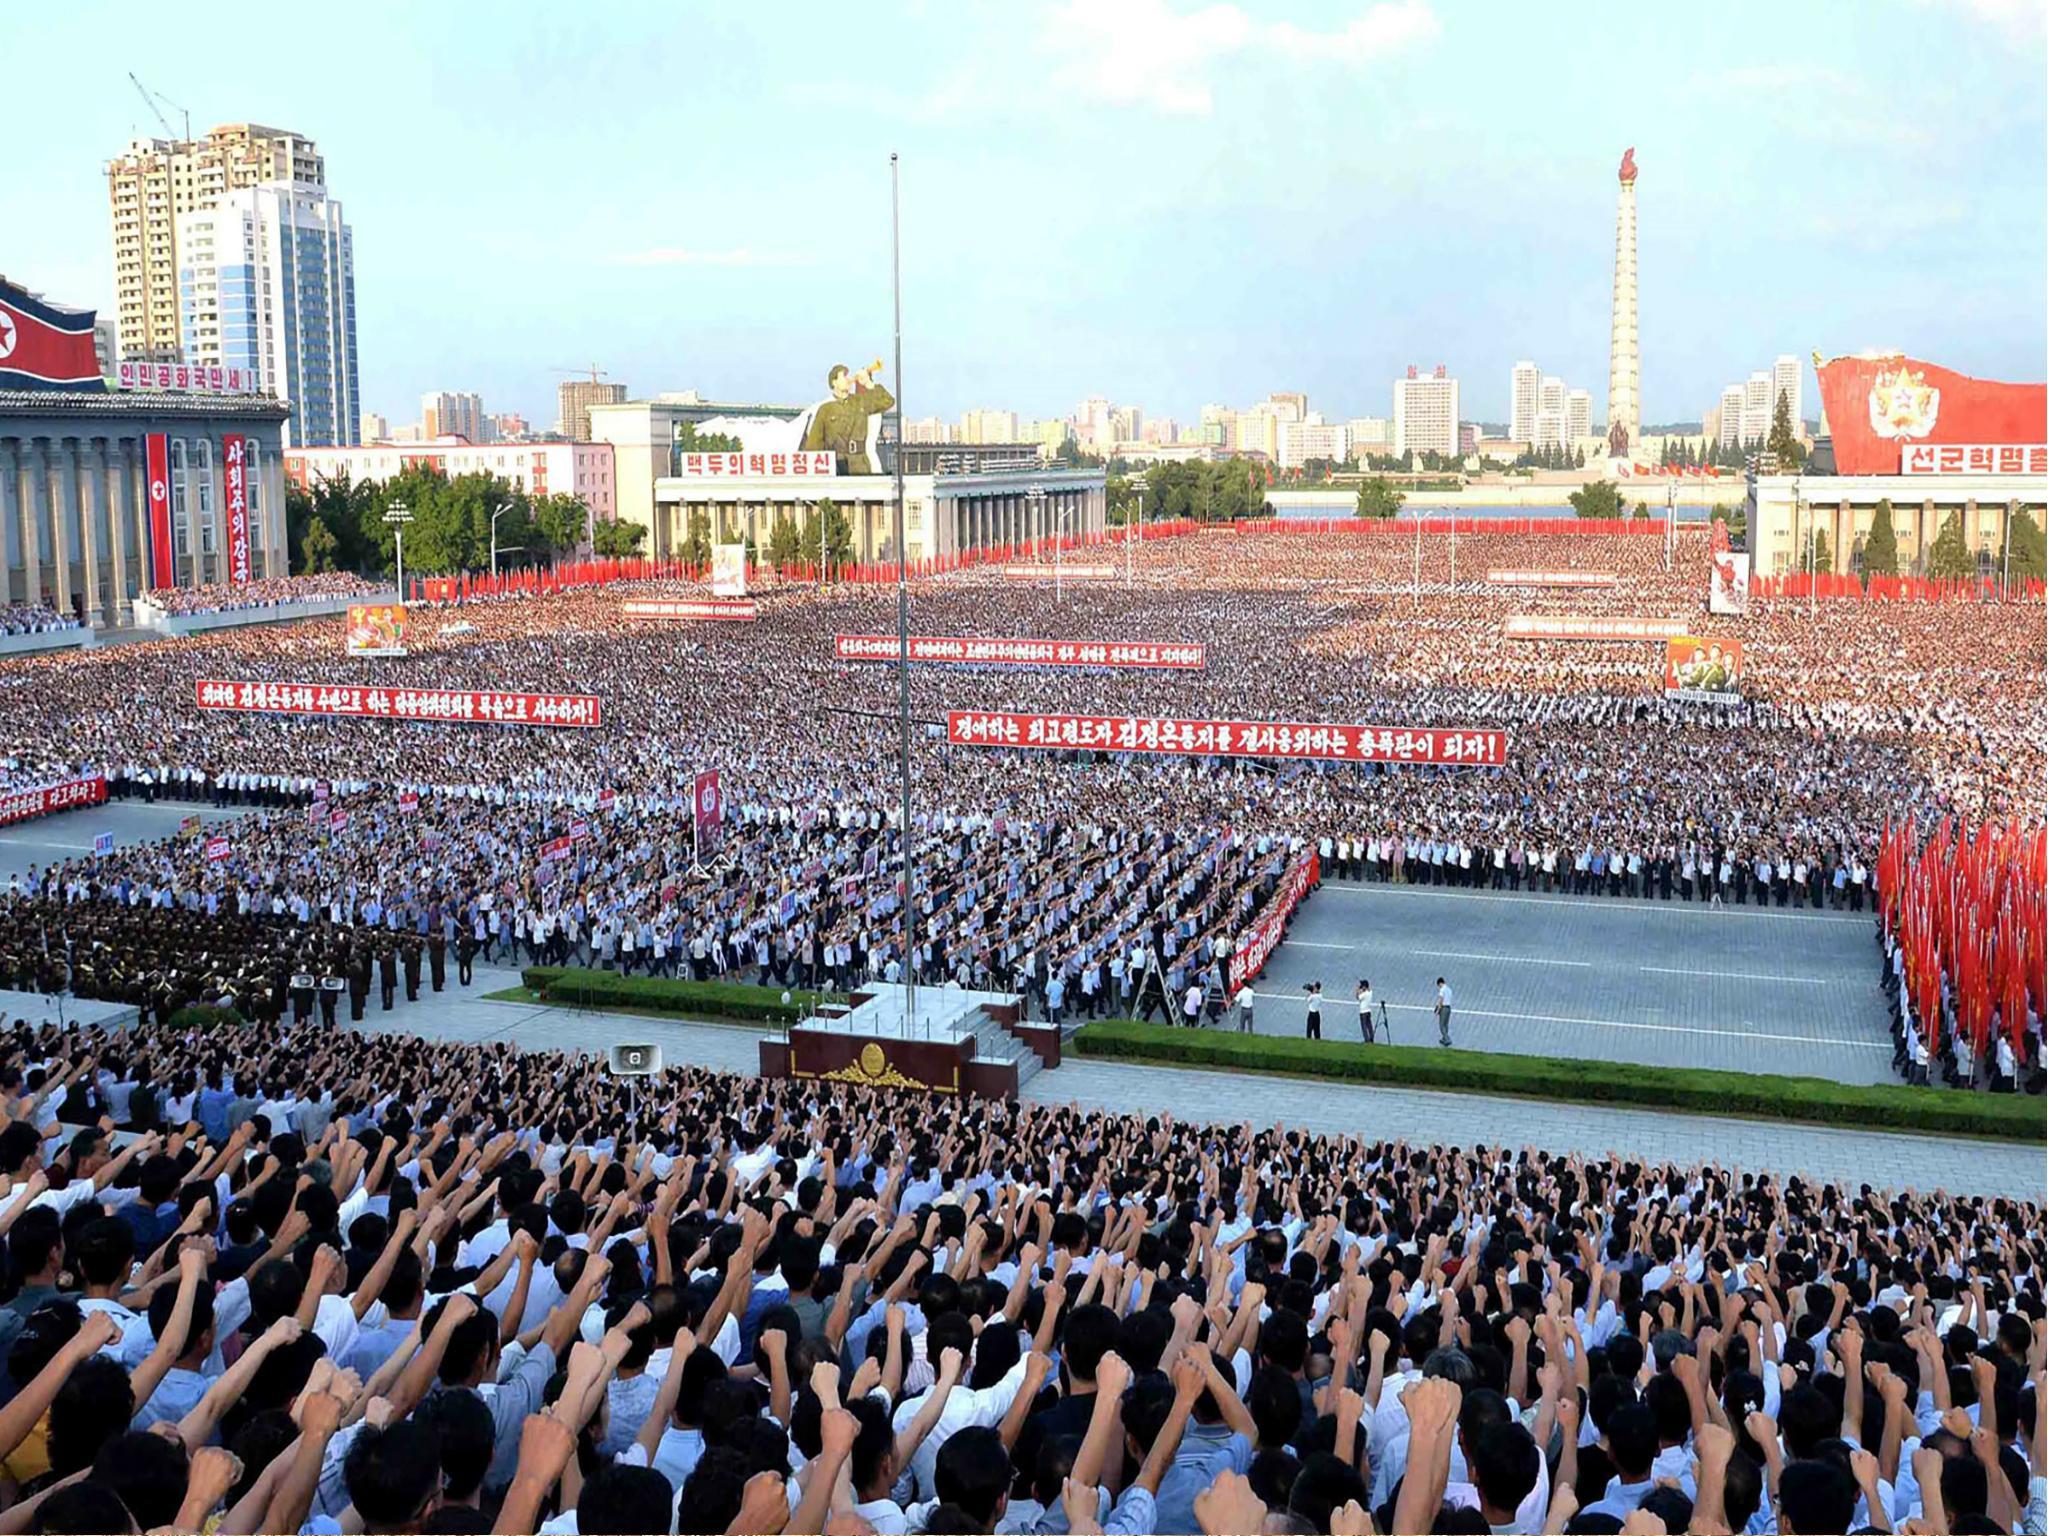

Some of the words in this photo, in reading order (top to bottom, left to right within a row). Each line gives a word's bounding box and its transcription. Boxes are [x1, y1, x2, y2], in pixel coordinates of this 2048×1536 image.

[202, 683, 235, 706] 위대한
[240, 683, 314, 710] 김정은동지를
[366, 690, 391, 714] 하는
[395, 690, 474, 718] 당중앙위원회를
[478, 695, 528, 720] 목숨으로
[532, 697, 594, 724] 사수하자!
[955, 715, 1021, 743] 경애하는
[1028, 719, 1113, 746] 최고령도자
[1115, 718, 1232, 751] 김정은동지를
[1237, 725, 1349, 755] 결사옹위하는
[1356, 729, 1434, 758] 총폭탄이
[1442, 733, 1495, 762] 되자!
